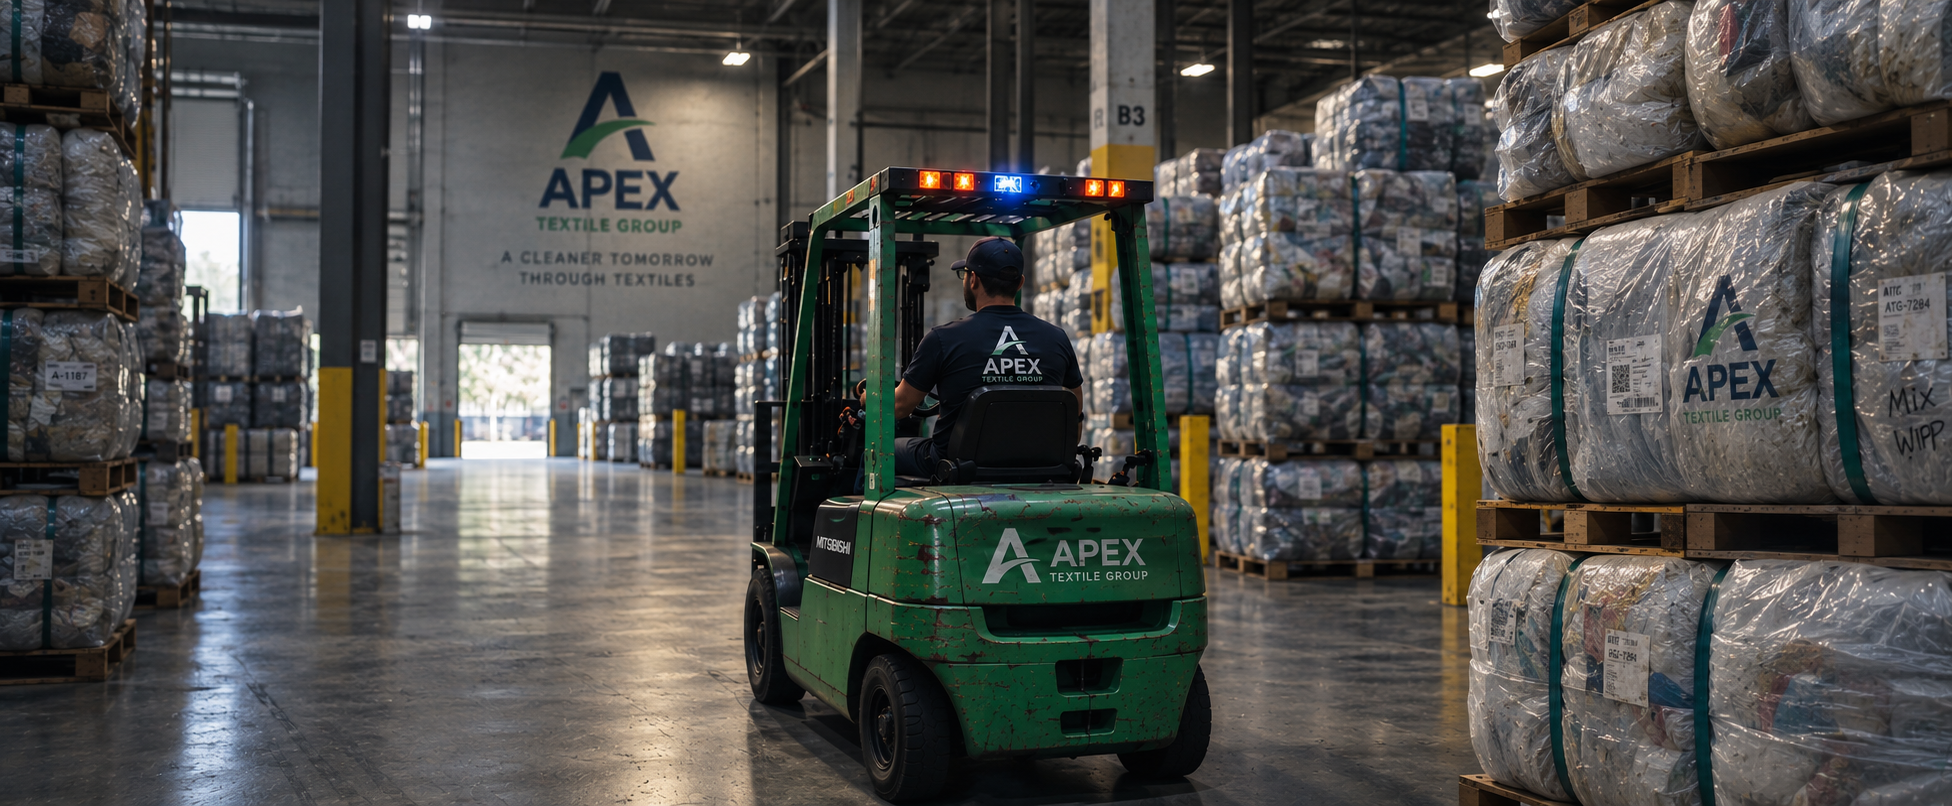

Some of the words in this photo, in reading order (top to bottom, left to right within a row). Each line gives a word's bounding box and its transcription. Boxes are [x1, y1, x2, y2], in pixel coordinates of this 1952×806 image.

[1118, 105, 1146, 127] B3
[538, 167, 681, 211] APEX
[536, 216, 610, 232] TEXTILE
[617, 218, 682, 234] GROUP
[501, 251, 513, 264] A
[520, 251, 603, 265] CLEANER
[610, 252, 714, 267] TOMORROW
[519, 271, 606, 286] THROUGH
[613, 273, 695, 287] TEXTILES
[983, 358, 1042, 375] APEX
[982, 375, 1014, 383] TEXTILE
[1017, 375, 1043, 383] GROUP
[1683, 359, 1780, 403] APEX
[1683, 409, 1730, 424] TEXTILE
[1734, 407, 1782, 422] GROUP
[1893, 420, 1945, 455] WIPP
[1050, 538, 1146, 567] APEX
[1050, 571, 1100, 582] TEXTILE
[1105, 571, 1148, 581] GROUP
